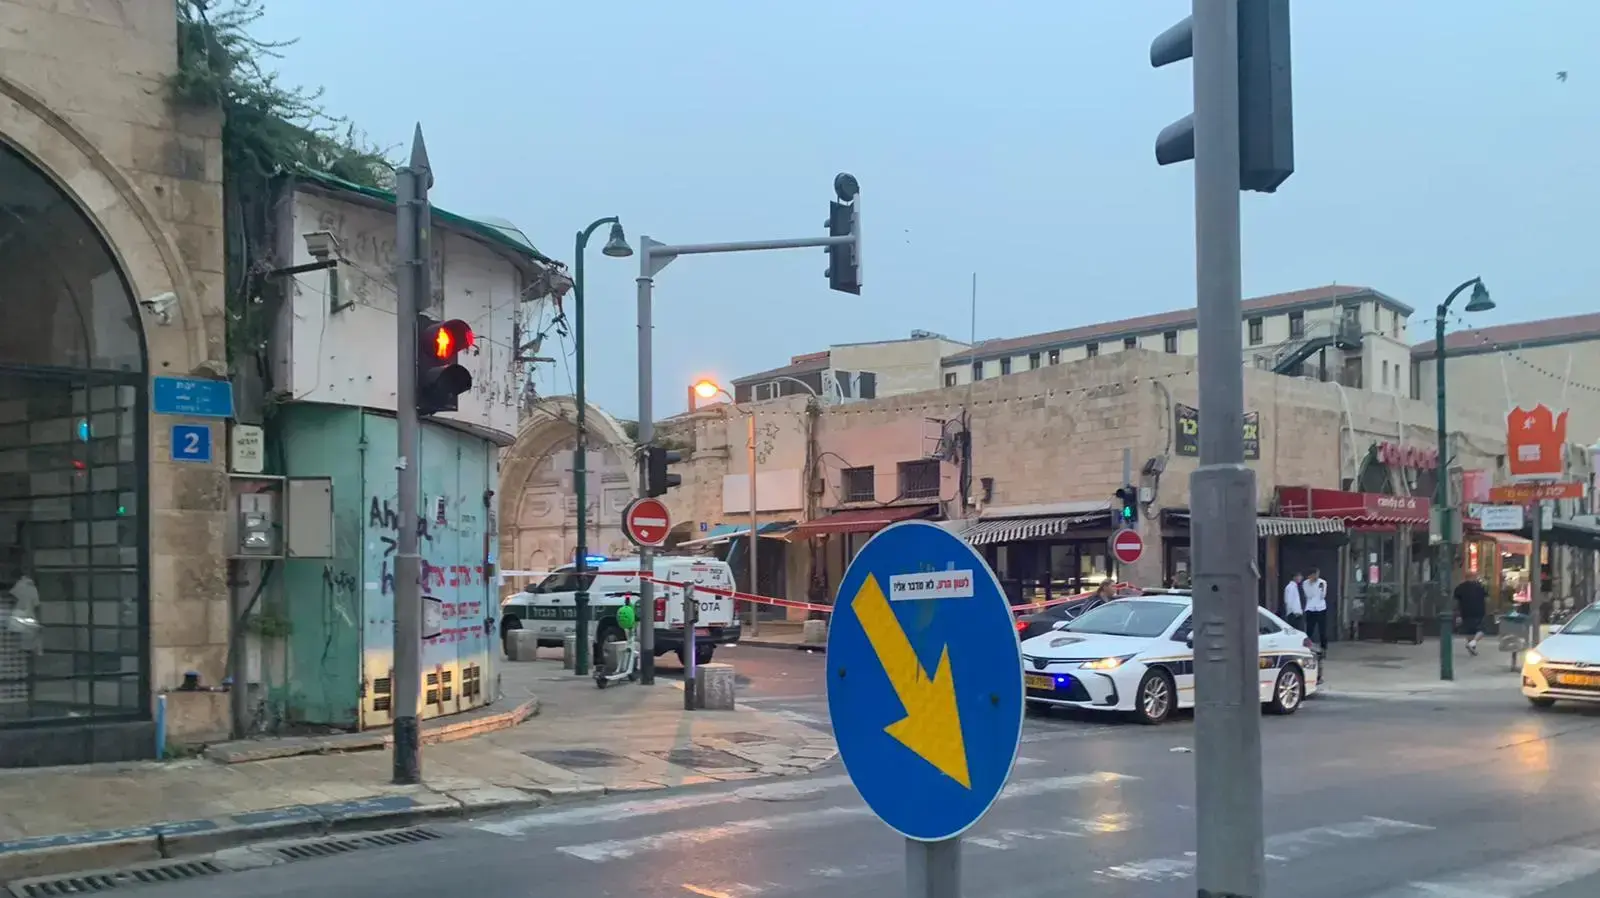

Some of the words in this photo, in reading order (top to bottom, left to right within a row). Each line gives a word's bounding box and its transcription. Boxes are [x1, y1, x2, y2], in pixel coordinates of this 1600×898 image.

[183, 432, 200, 454] 2
[907, 581, 924, 591] מדבר
[925, 579, 934, 590] לא
[953, 576, 969, 590] לשון
[680, 602, 721, 611] TOTA
